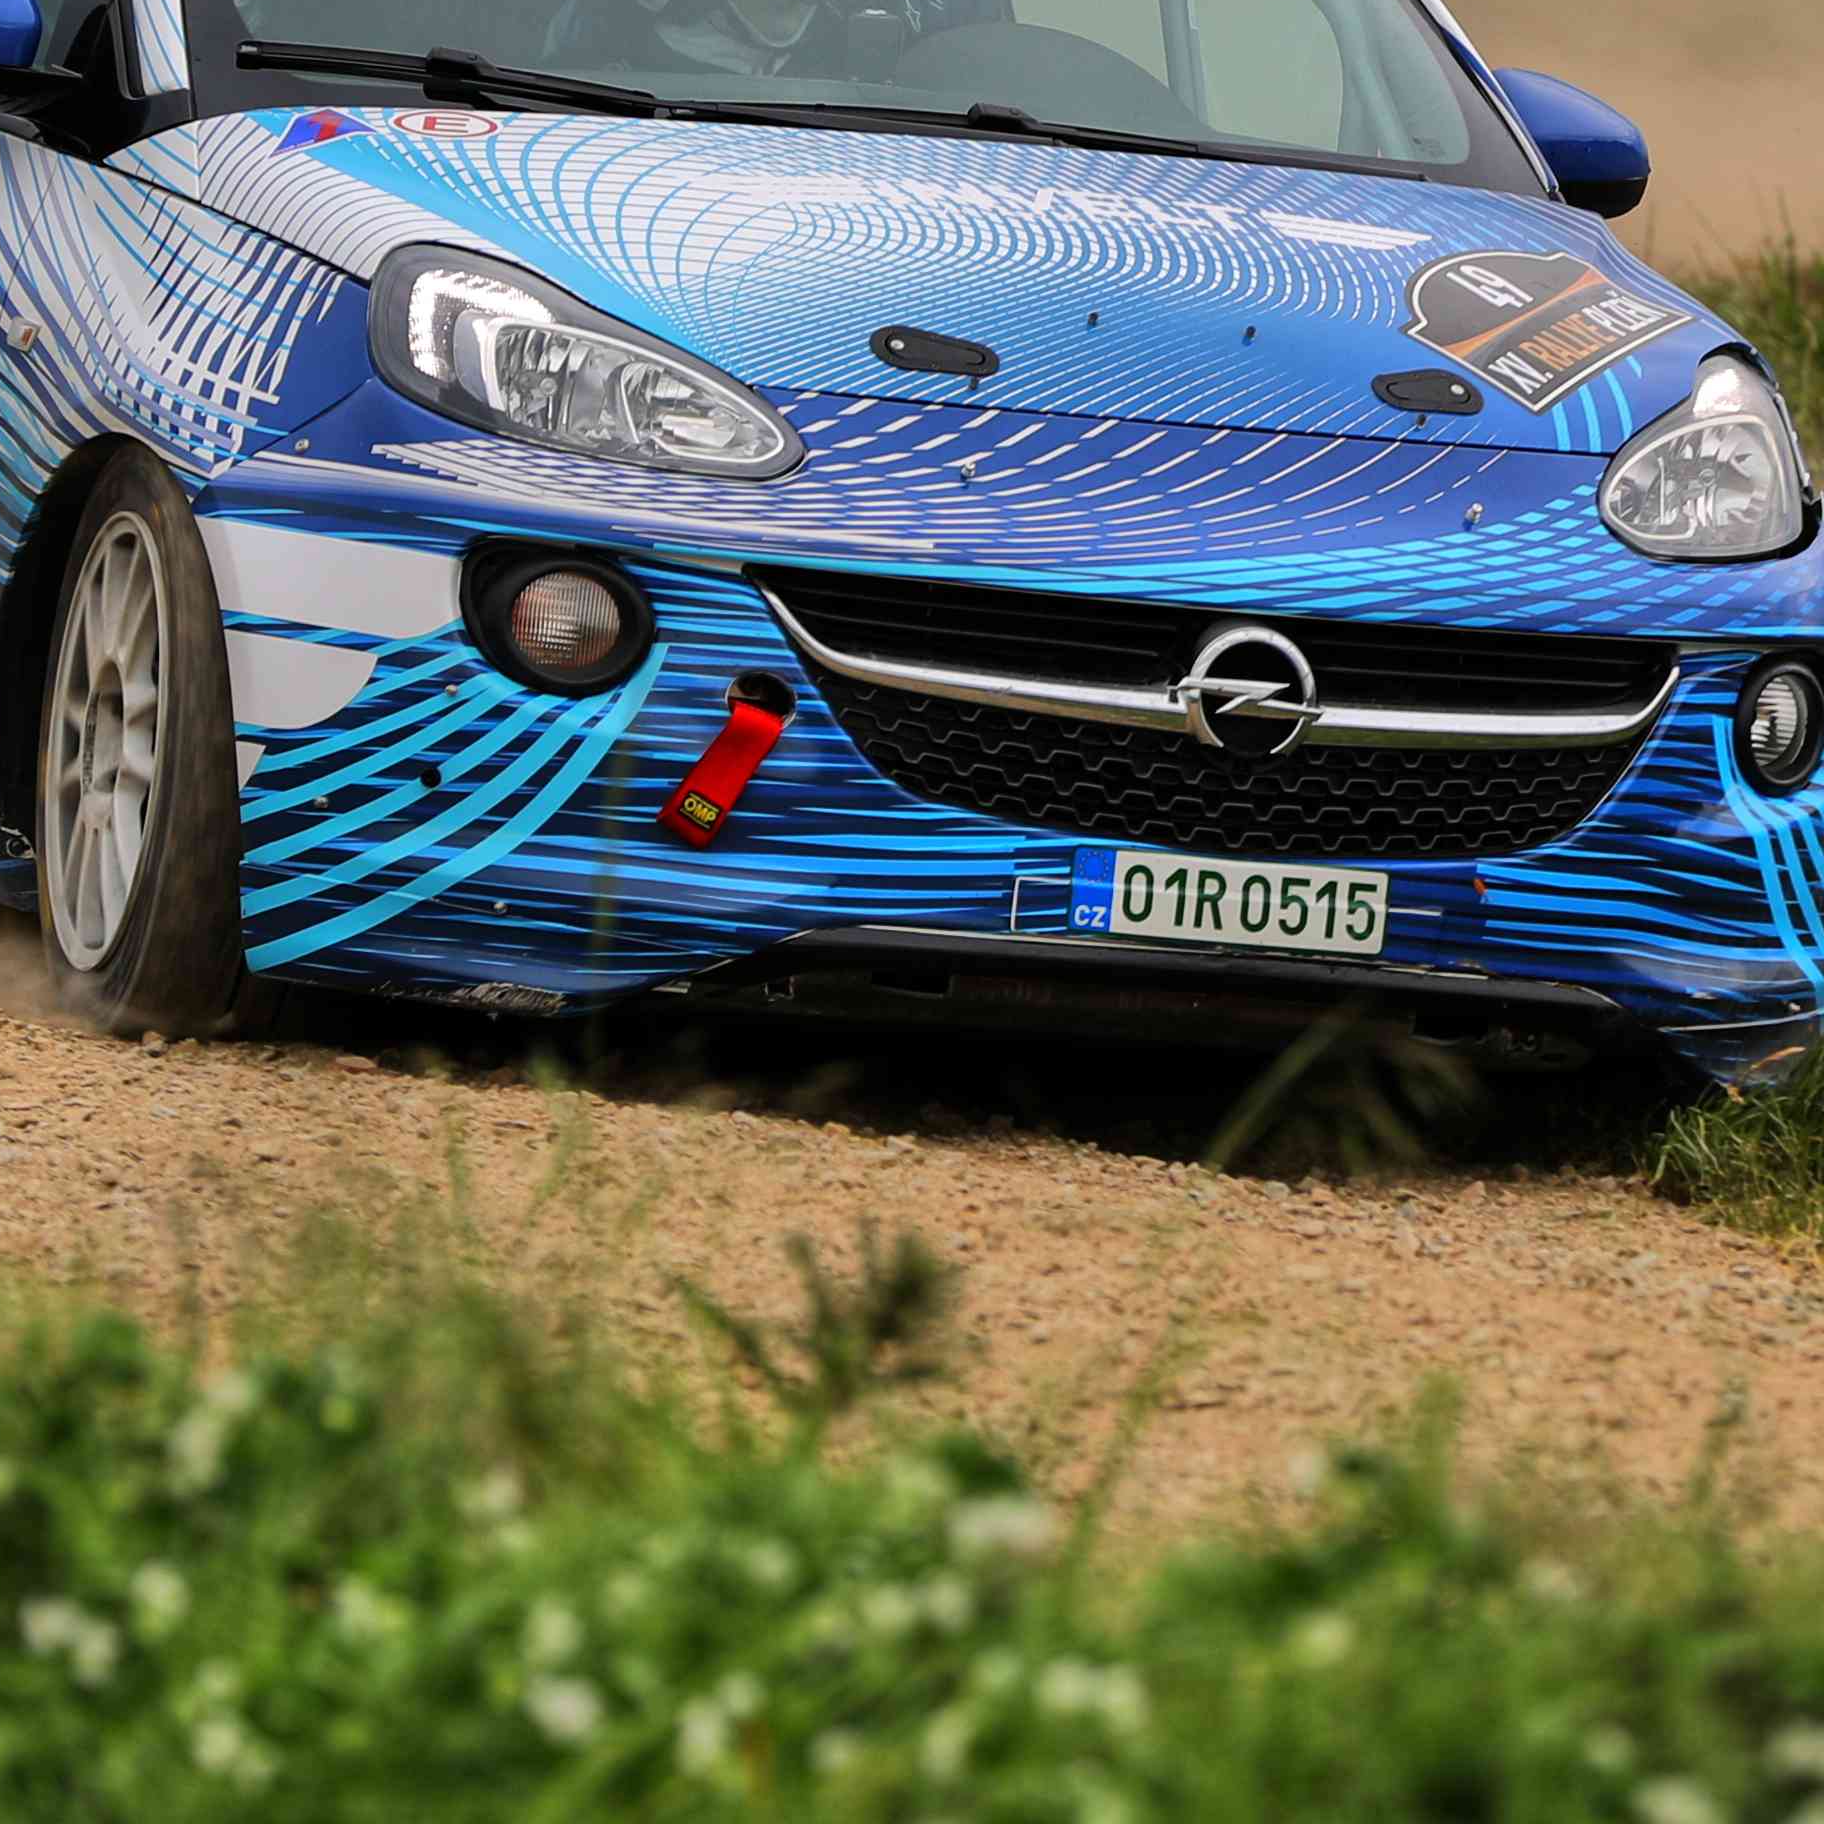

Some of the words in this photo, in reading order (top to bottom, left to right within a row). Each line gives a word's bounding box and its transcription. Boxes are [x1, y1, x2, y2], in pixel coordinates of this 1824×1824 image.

[1446, 264, 1535, 309] 49
[1580, 289, 1670, 338] PLZEŇ
[1519, 314, 1618, 373] RALLYE
[1487, 351, 1555, 396] XV.
[683, 797, 717, 823] OMP
[1073, 903, 1107, 929] CZ
[1121, 863, 1228, 931] 01R
[1238, 873, 1379, 943] 0515
